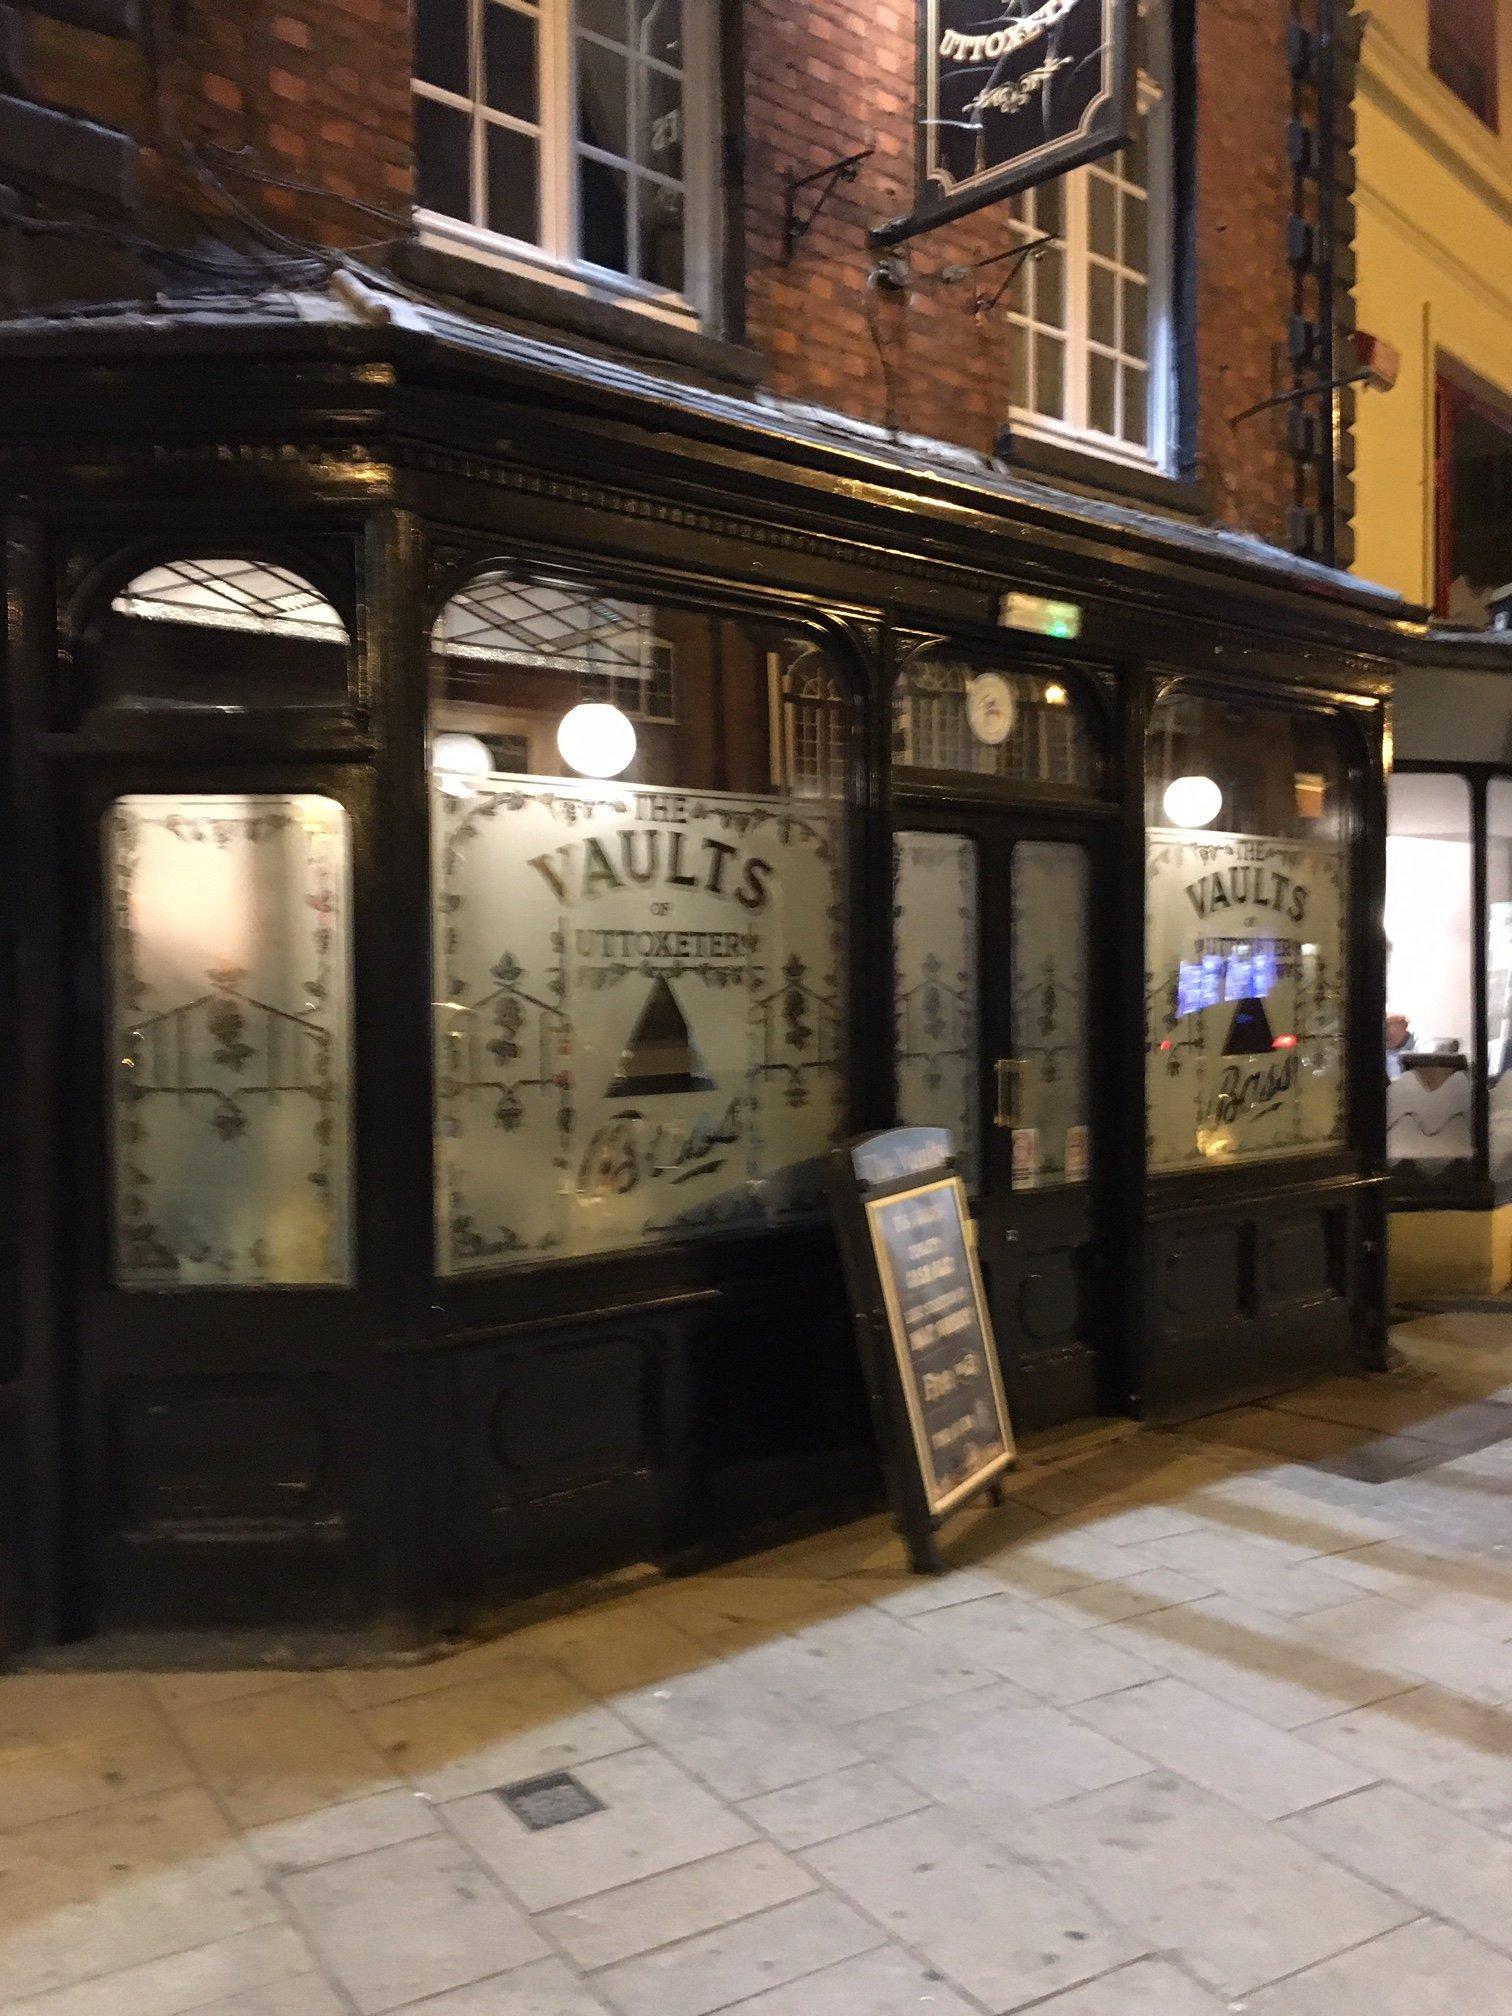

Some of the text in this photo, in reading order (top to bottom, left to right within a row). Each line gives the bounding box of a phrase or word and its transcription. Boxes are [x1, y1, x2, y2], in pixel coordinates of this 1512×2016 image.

[635, 794, 689, 824] THE
[1237, 841, 1269, 861] THE
[527, 830, 774, 909] VAULTS
[1186, 866, 1308, 923] VAULTS
[575, 929, 741, 957] UTTOXETER
